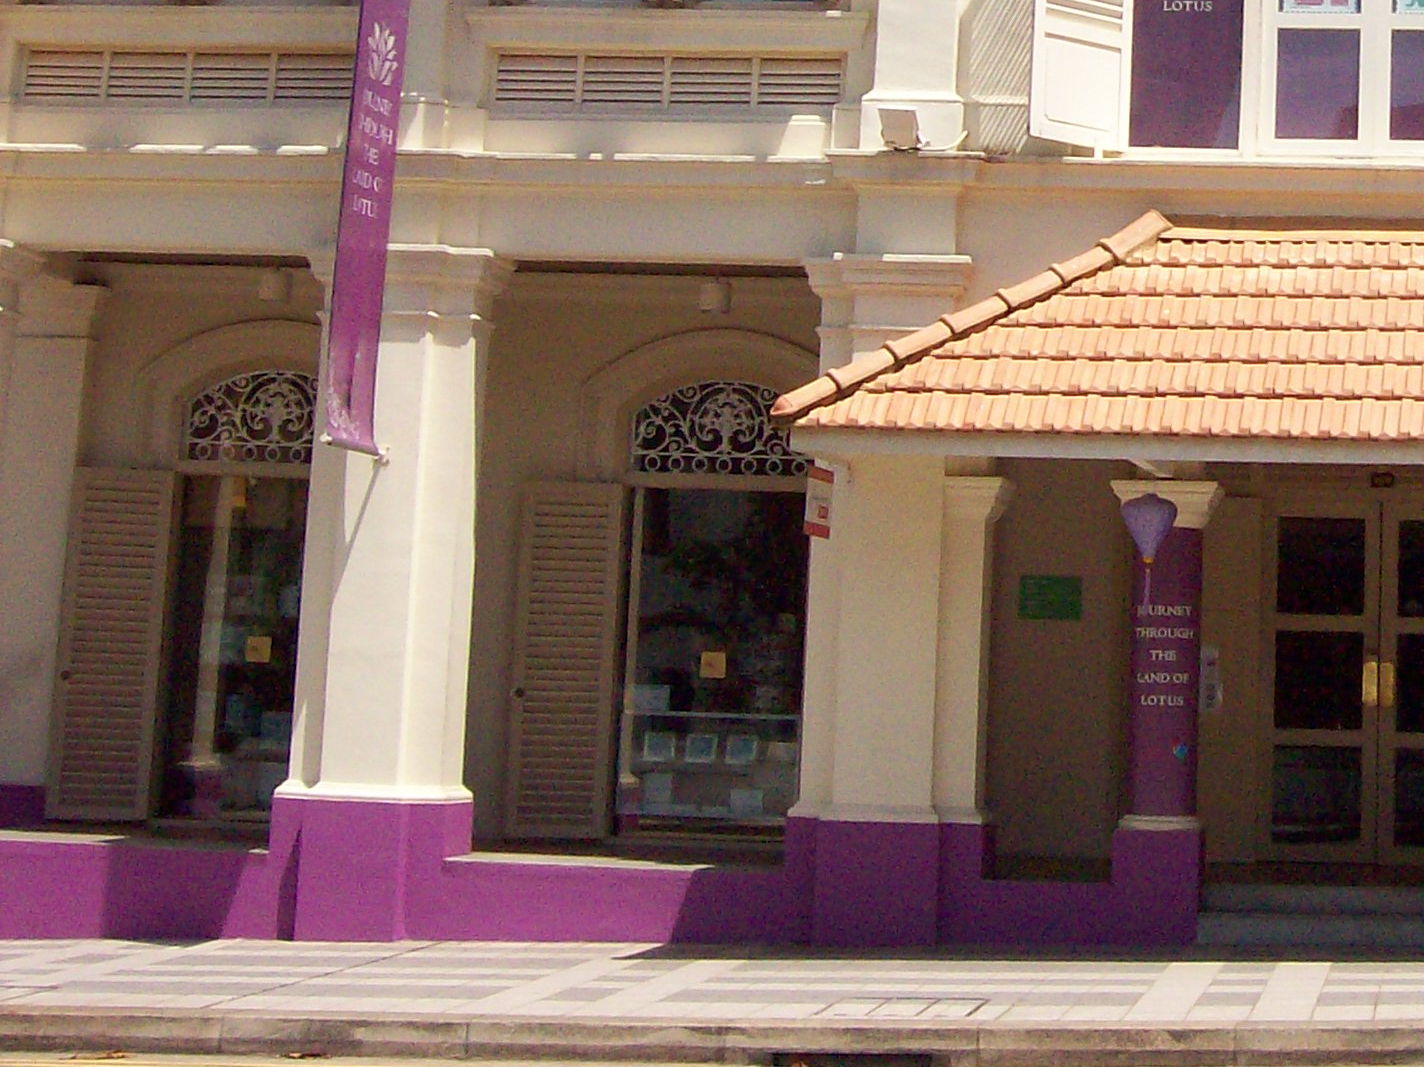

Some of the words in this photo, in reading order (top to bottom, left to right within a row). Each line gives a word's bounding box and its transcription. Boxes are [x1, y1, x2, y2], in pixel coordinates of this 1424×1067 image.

[1162, 0, 1214, 13] LOTUS
[1137, 604, 1193, 617] JURNEY
[1136, 627, 1195, 639] THROUGH
[1149, 649, 1177, 662] THE
[1137, 672, 1171, 685] LAND
[1140, 695, 1185, 707] LOTUS
